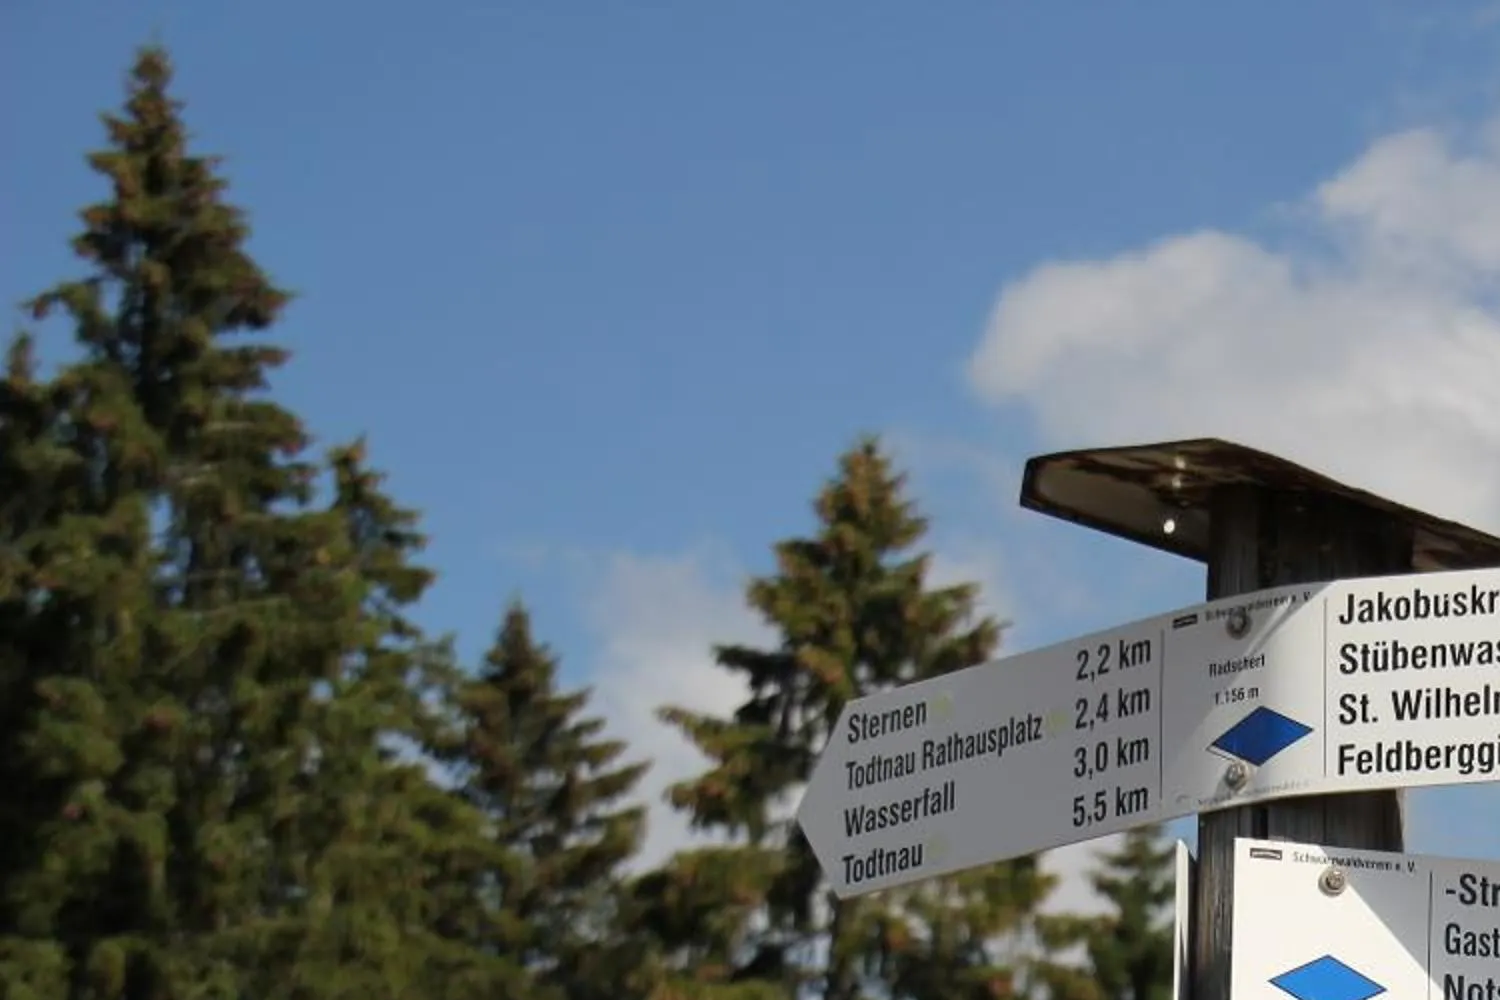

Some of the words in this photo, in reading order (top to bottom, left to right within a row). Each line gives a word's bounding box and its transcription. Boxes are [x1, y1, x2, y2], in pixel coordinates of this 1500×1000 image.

[845, 751, 916, 790] Todtnau
[922, 713, 1043, 771] Rathausplatz
[1075, 692, 1109, 730] 2,4
[1117, 687, 1151, 719] km
[847, 701, 927, 744] Sternen
[1075, 643, 1111, 682] 2,2
[1118, 639, 1151, 670] km
[1338, 693, 1379, 726] St.
[841, 843, 923, 887] Todtnau
[1072, 789, 1107, 828] 5,5
[1115, 785, 1149, 817] km
[844, 780, 955, 838] Wasserfall
[1073, 741, 1109, 780] 3,0
[1116, 737, 1150, 769] km
